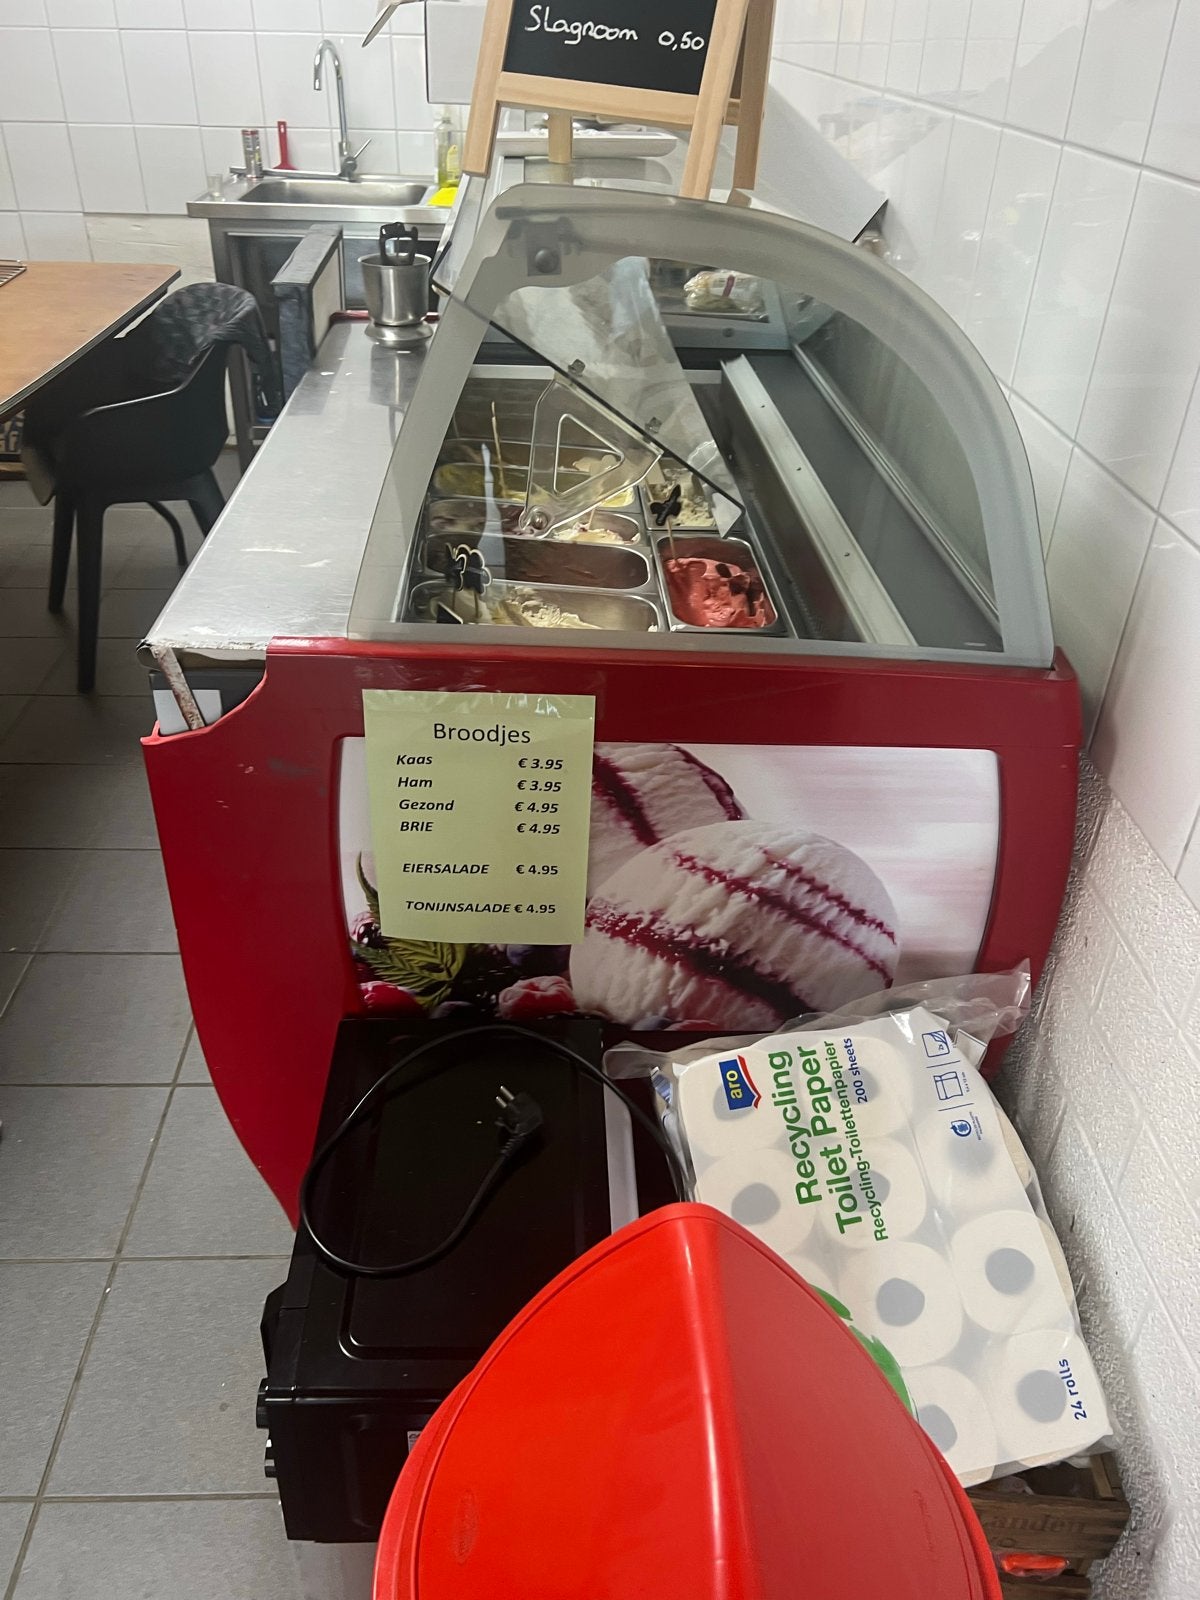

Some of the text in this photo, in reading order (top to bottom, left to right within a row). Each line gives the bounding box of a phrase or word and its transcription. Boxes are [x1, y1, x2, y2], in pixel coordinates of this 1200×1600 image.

[524, 4, 705, 51] Slagroom 0,50
[433, 722, 531, 747] Broodjes
[396, 754, 564, 771] Kaas € 3.95
[397, 776, 562, 793] Ham € 3.95
[398, 798, 560, 814] Gezond € 4.95
[399, 820, 561, 835] BRIE € 4.95
[402, 862, 559, 876] EIERSALADE € 4.95
[405, 900, 556, 914] TONIJNSALADE € 4.95
[843, 1038, 868, 1103] 200 sheets
[726, 1070, 743, 1099] aro
[767, 1051, 823, 1204] Recycling
[797, 1046, 863, 1234] Toilet Paper
[823, 1041, 889, 1241] Recycling-Toilettenpapier
[1058, 1358, 1087, 1420] 24 rolls
